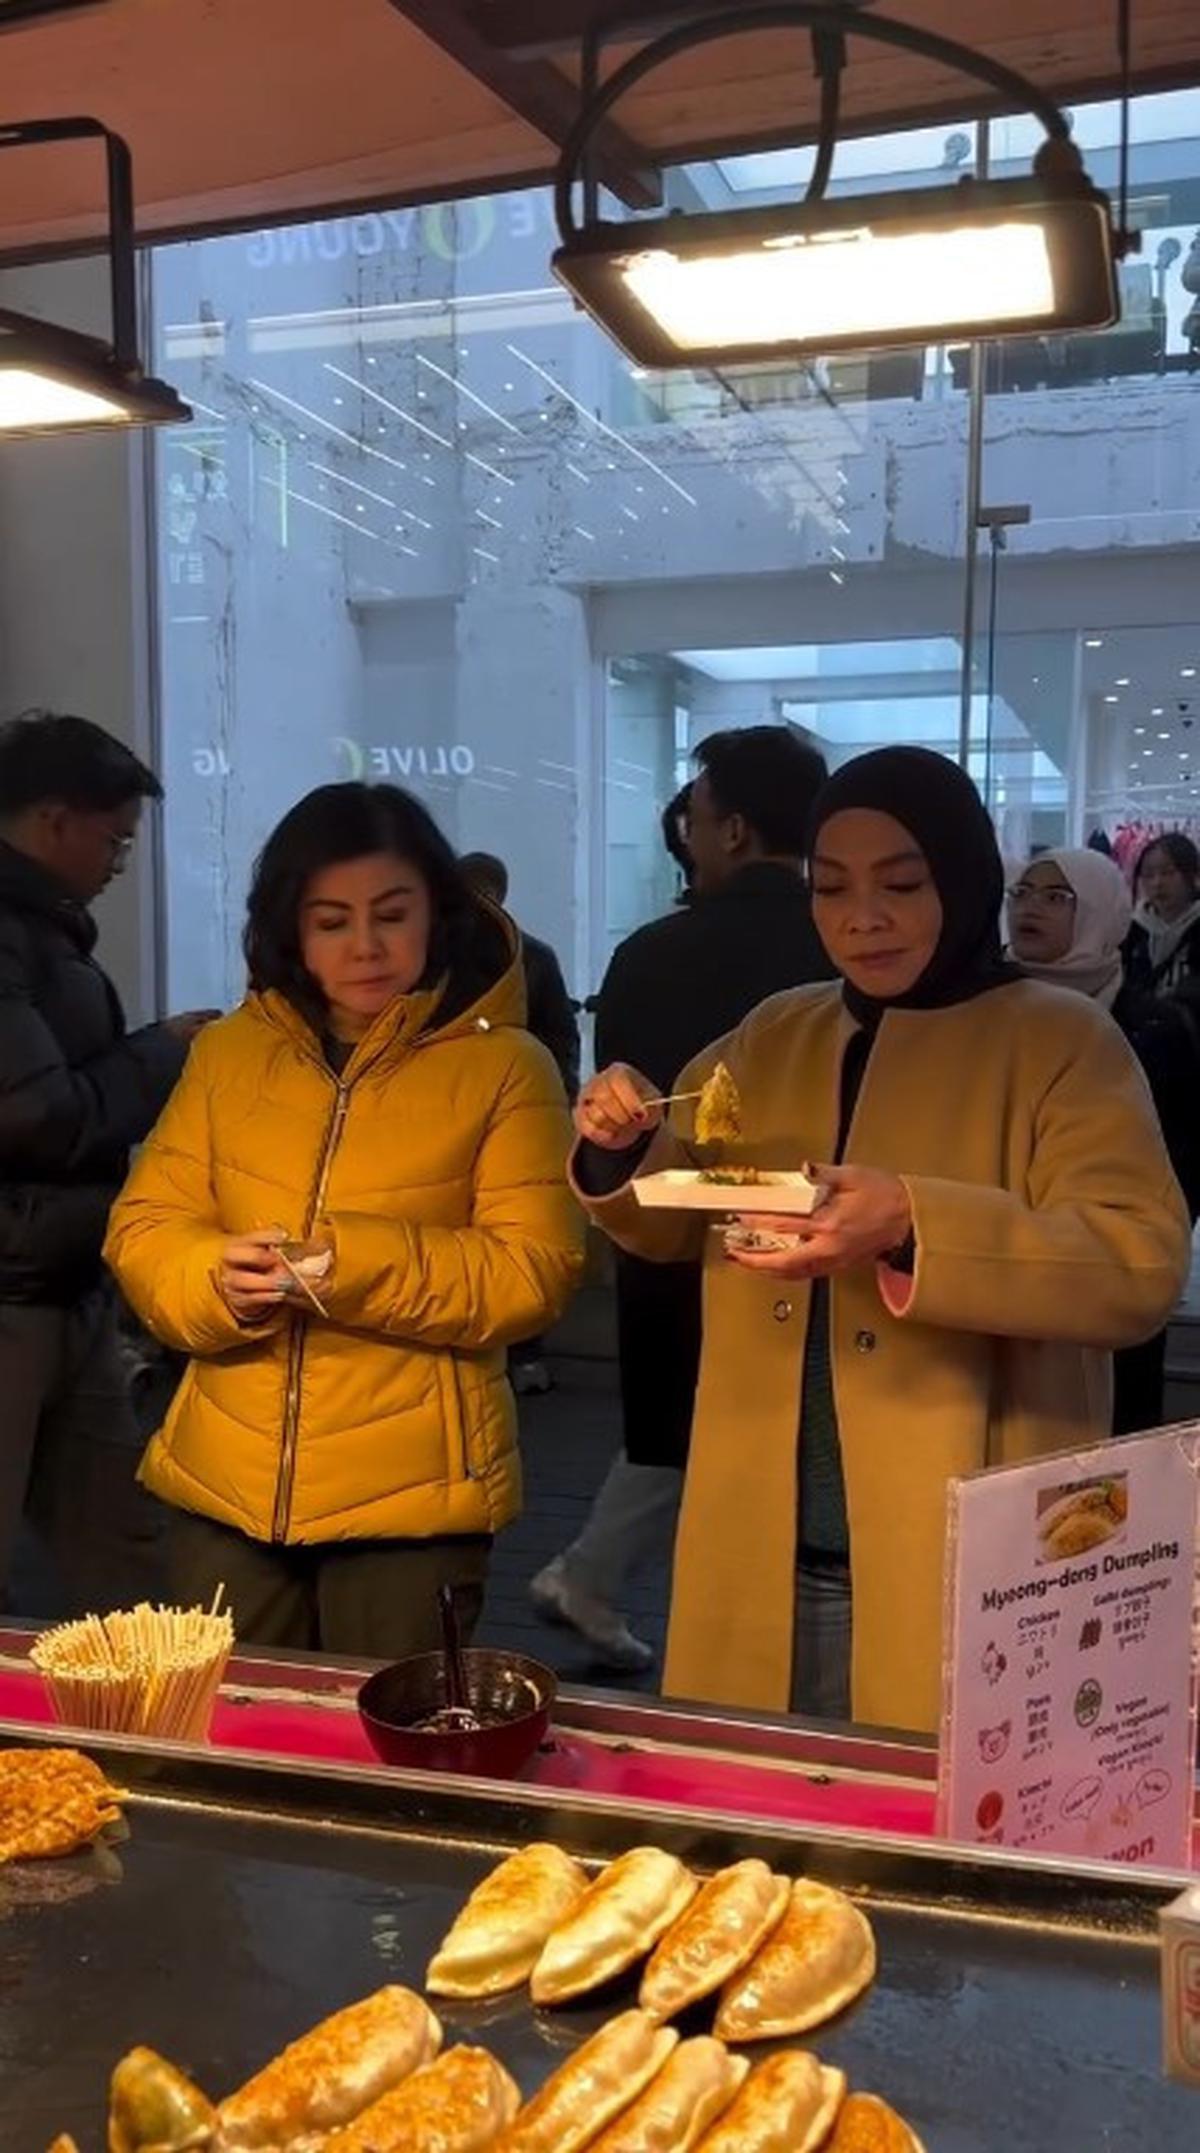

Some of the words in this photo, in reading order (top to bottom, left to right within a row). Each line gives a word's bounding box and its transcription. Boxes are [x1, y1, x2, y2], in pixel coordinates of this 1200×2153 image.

[981, 1564, 1098, 1613] Myeong-dong
[1103, 1541, 1179, 1574] Dumpling
[1017, 1610, 1060, 1629] Chicken
